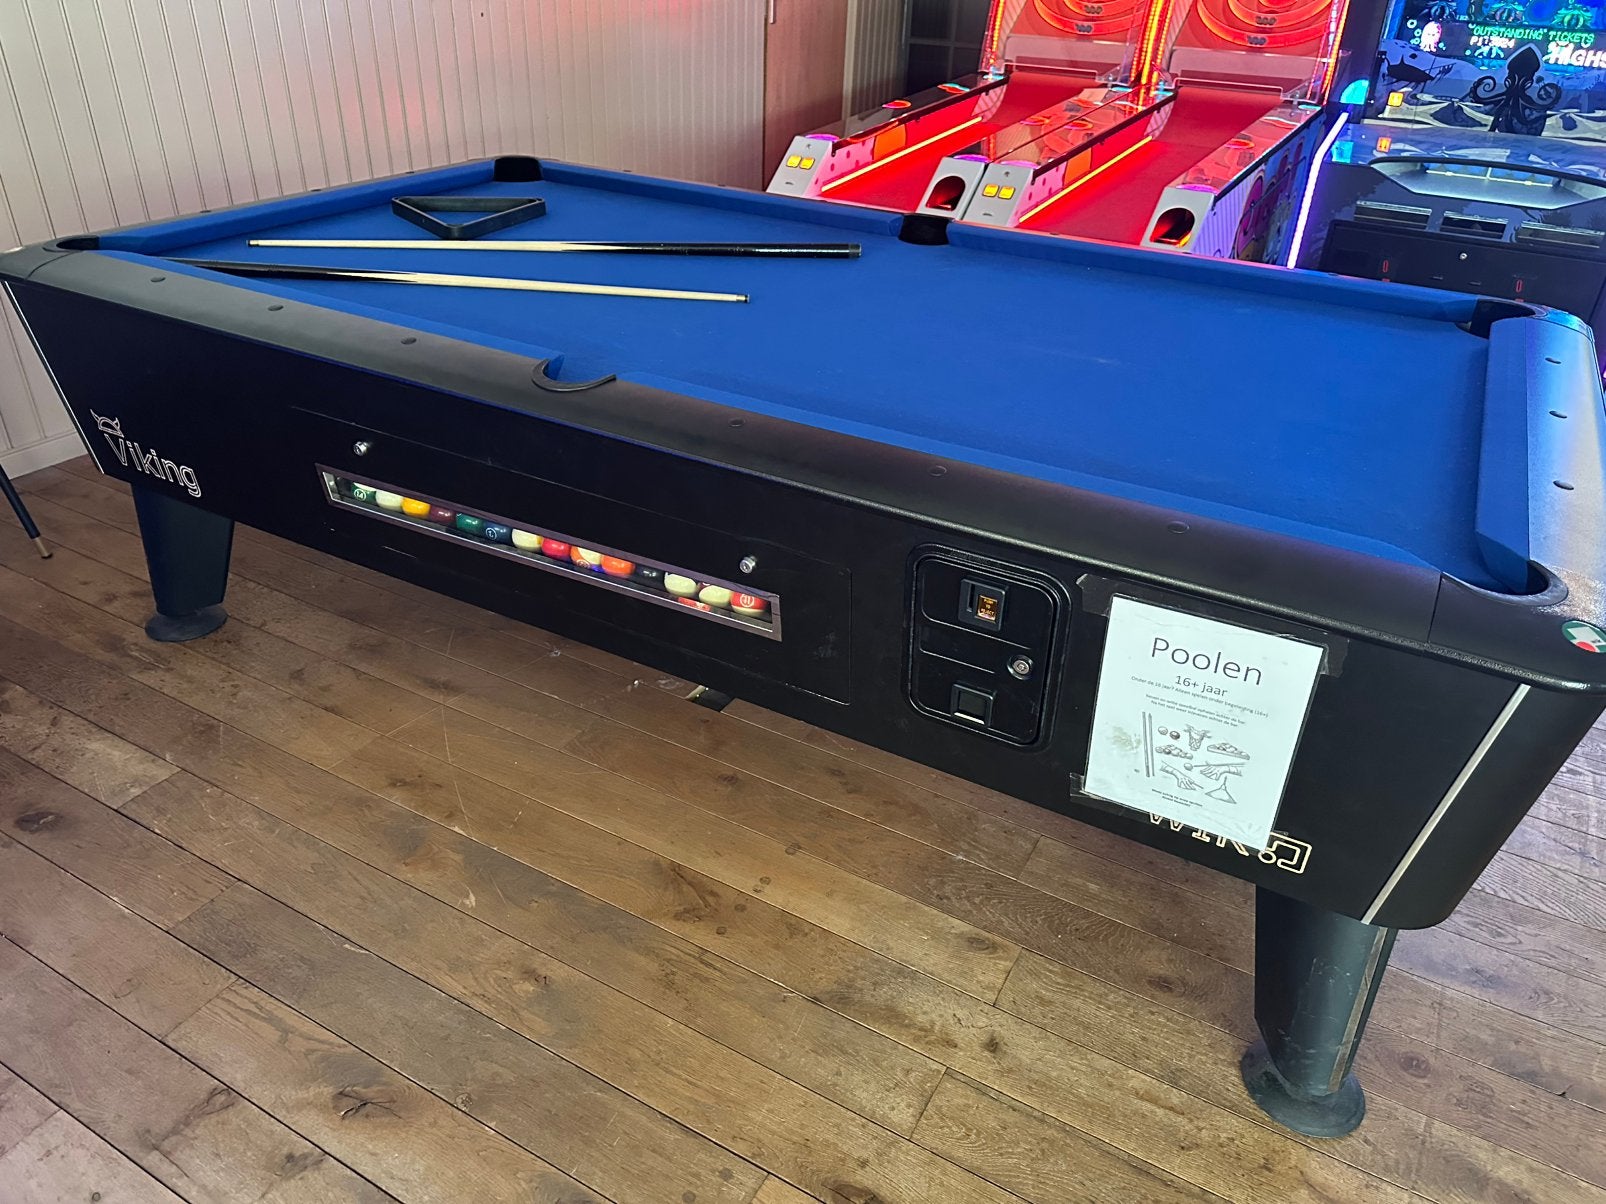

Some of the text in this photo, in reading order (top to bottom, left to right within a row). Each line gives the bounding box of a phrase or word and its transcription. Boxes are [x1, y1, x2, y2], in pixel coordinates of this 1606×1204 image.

[1549, 31, 1595, 44] TICKETS
[103, 433, 202, 498] Viking
[1151, 637, 1263, 685] Poolen
[1175, 675, 1228, 697] 16+ jaar
